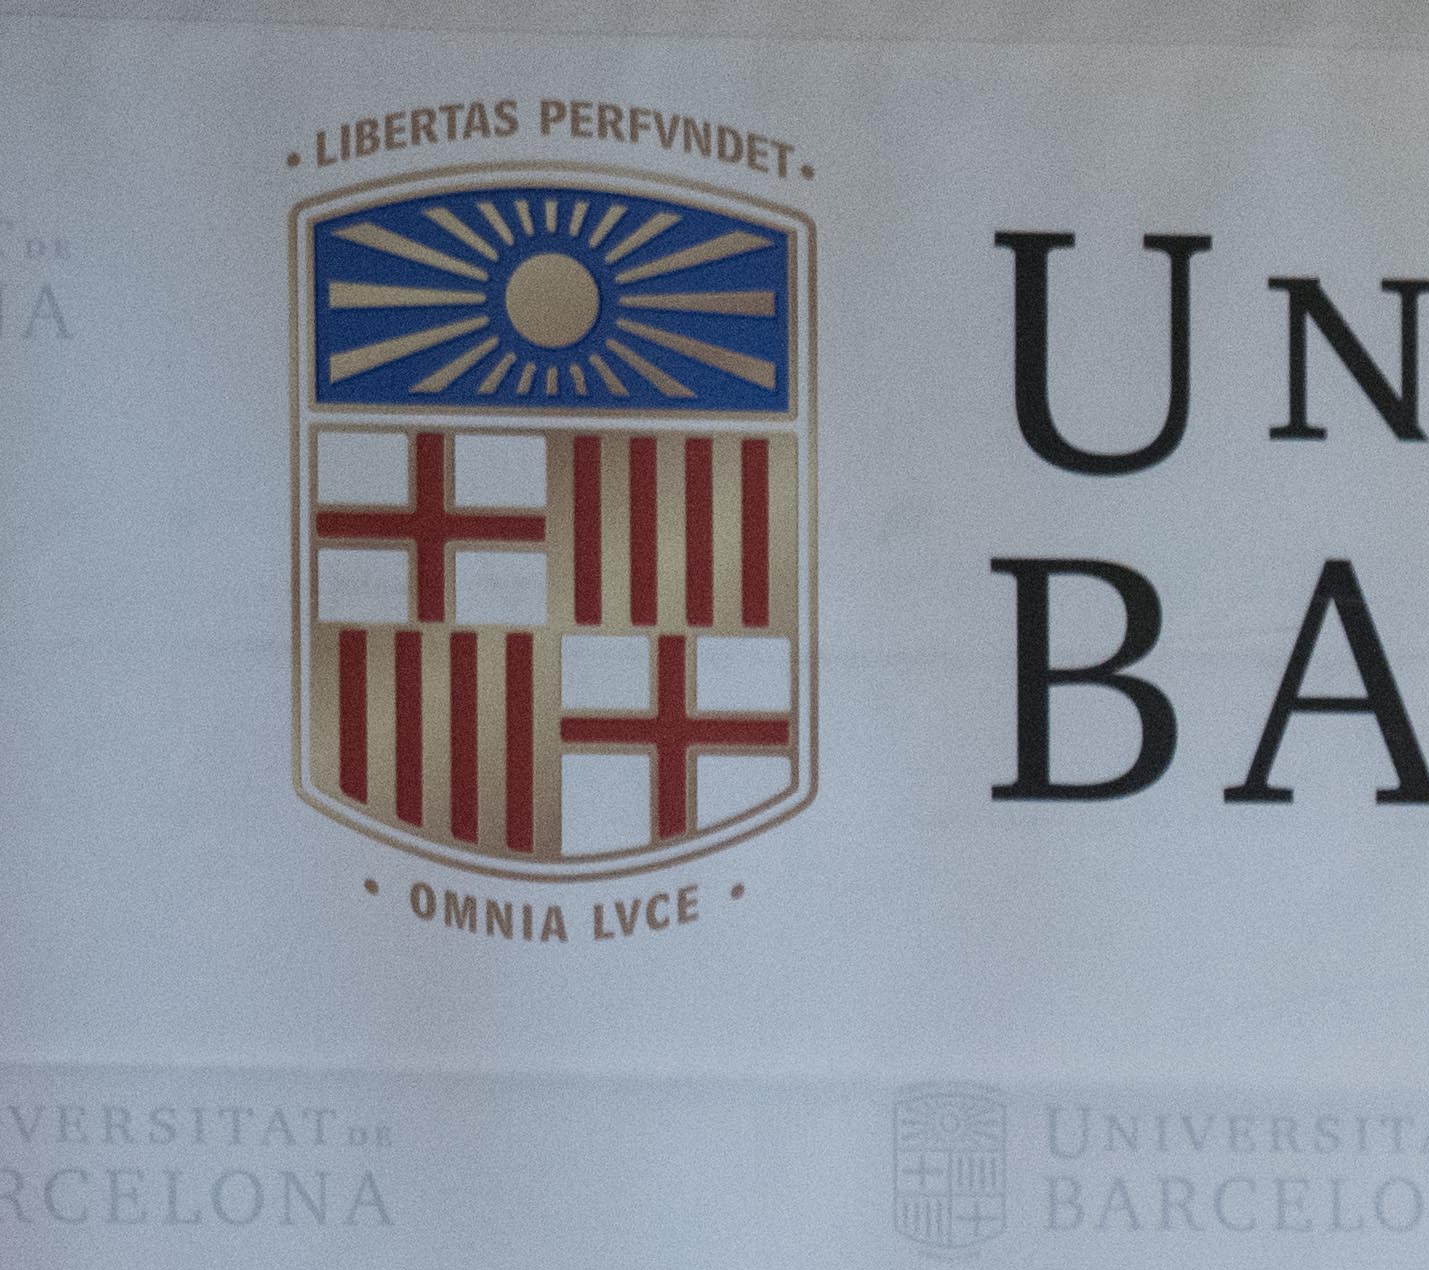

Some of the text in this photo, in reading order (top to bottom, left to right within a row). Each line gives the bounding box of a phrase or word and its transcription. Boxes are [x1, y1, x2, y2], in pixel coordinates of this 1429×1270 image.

[315, 98, 796, 179] LIBERTAS PERFVNDET
[409, 882, 701, 943] OMNIA LVCE
